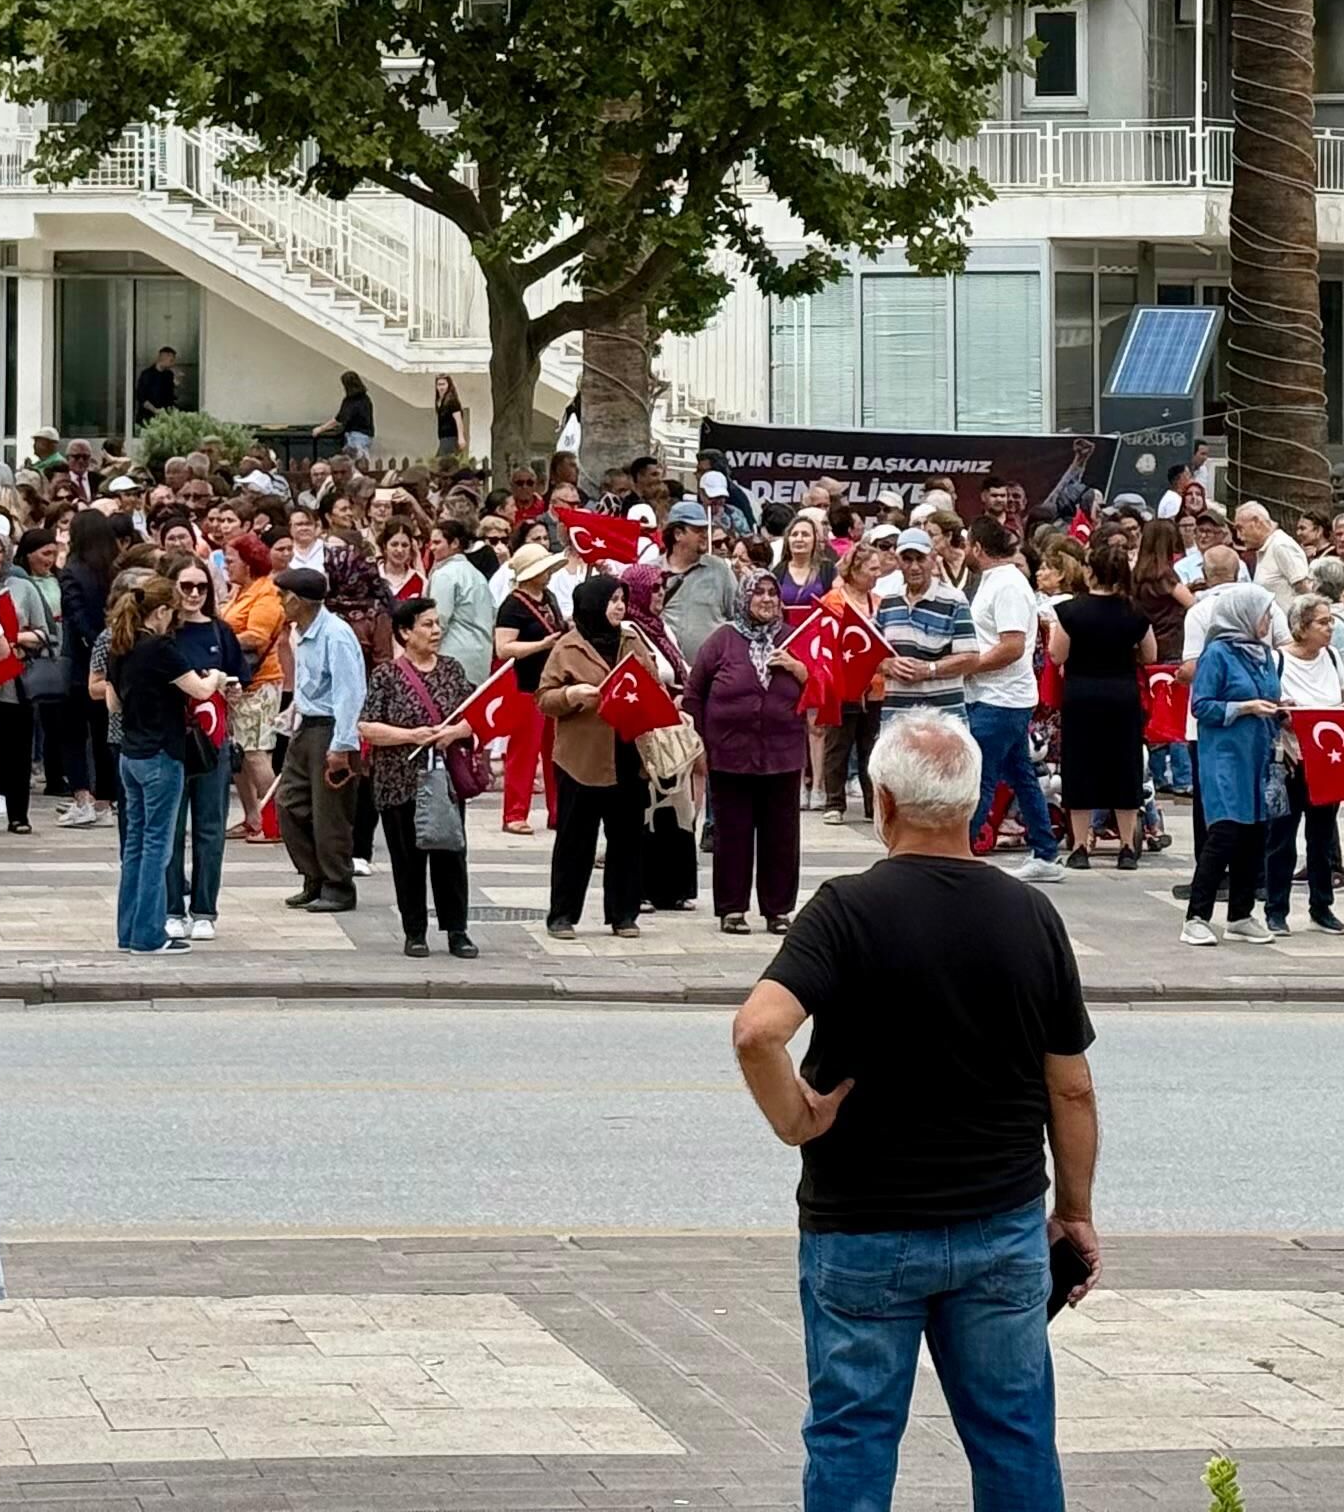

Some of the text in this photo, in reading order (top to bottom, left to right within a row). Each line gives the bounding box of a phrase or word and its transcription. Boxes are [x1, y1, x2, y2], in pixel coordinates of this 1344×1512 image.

[726, 451, 993, 474] AYIN GENEL BAŞKANIMIZ
